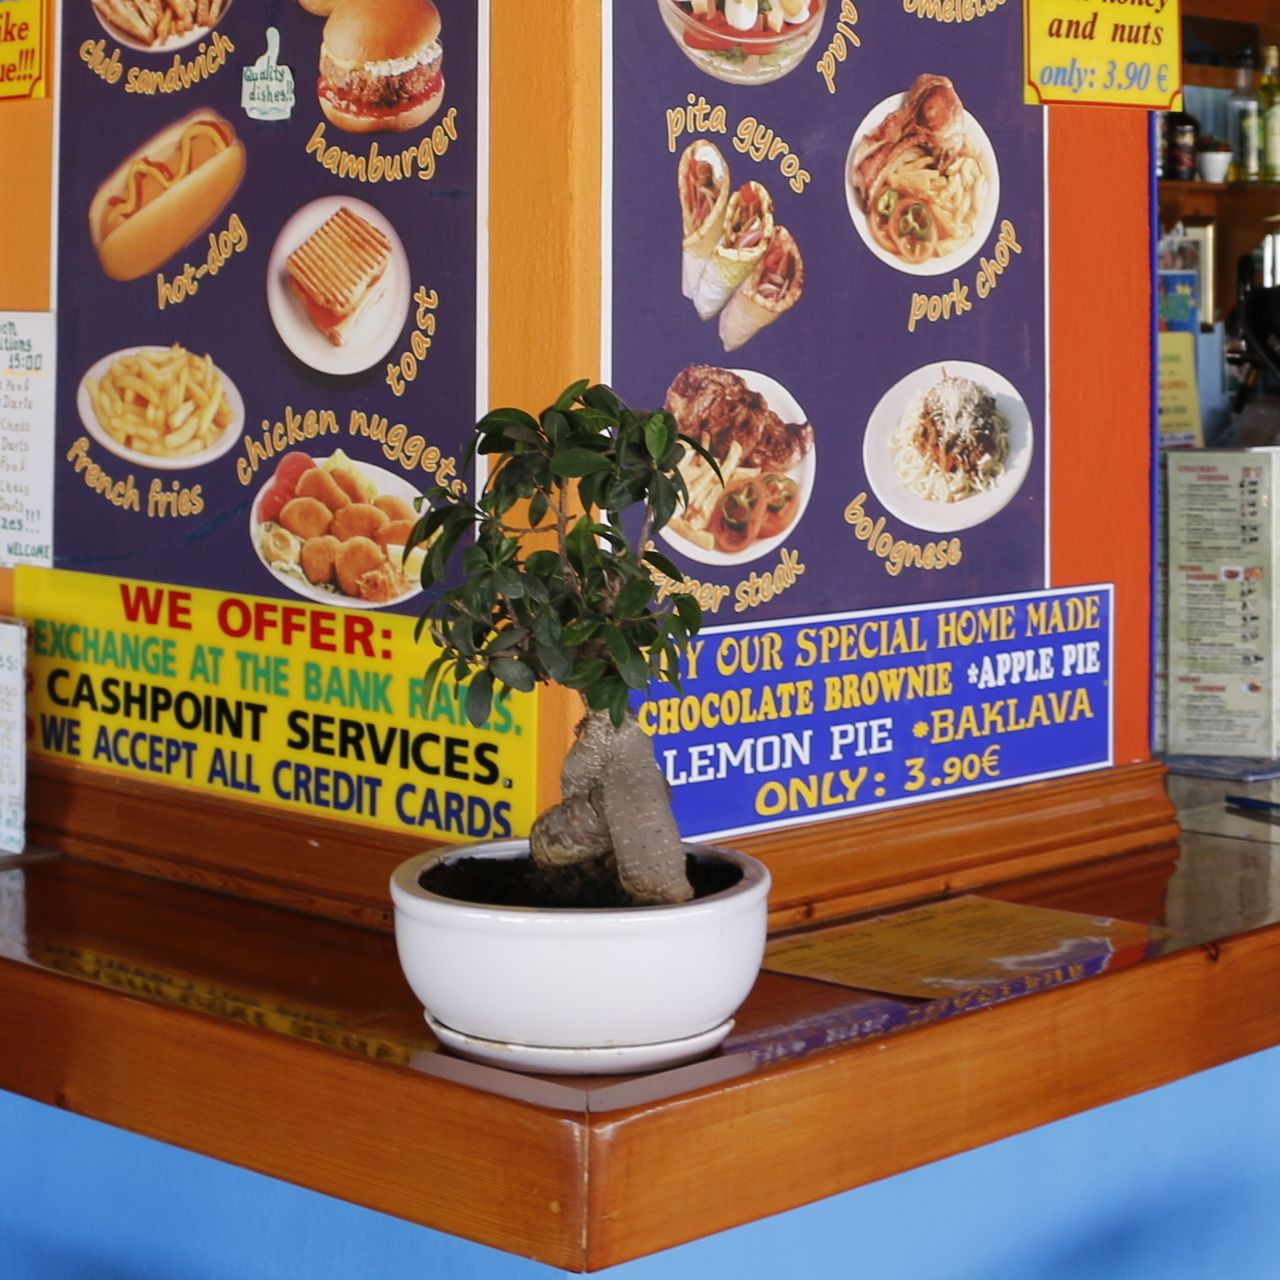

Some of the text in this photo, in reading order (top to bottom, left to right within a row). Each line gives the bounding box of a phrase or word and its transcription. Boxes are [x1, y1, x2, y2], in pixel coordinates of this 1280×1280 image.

[79, 31, 235, 95] club sandwich
[244, 56, 284, 82] Quality
[1048, 13, 1163, 46] and nuts
[1040, 58, 1169, 92] only: 3.90 €
[305, 108, 458, 183] hamburger
[666, 93, 811, 194] pita gyros
[156, 213, 248, 310] hot-dog
[907, 219, 1022, 332] pork chop
[386, 286, 439, 396] toast
[67, 436, 205, 518] french fries
[237, 406, 468, 503] chicken nuggets
[844, 492, 961, 576] bolognese
[734, 547, 805, 612] steak
[120, 584, 393, 660] WE OFFER:
[717, 637, 783, 676] OUR
[795, 617, 927, 666] SPECIAL
[937, 605, 1015, 649] HOME
[1026, 596, 1101, 636] MADE
[35, 620, 178, 671] EXCHANGE
[190, 645, 223, 684] AT
[236, 653, 289, 697] THE
[303, 663, 393, 714] BANK
[637, 641, 1101, 737] CHOCOLATE BROWNIE APPLE PIE
[40, 713, 80, 757] WE
[93, 725, 196, 778] ACCEPT
[208, 749, 260, 793] ALL
[273, 760, 381, 818] CREDIT
[47, 669, 267, 743] CASHPOINT
[288, 710, 513, 788] SERVICES.
[663, 731, 812, 786] LEMON
[830, 718, 893, 762] PIE
[754, 745, 1001, 816] ONLY: 3.90€
